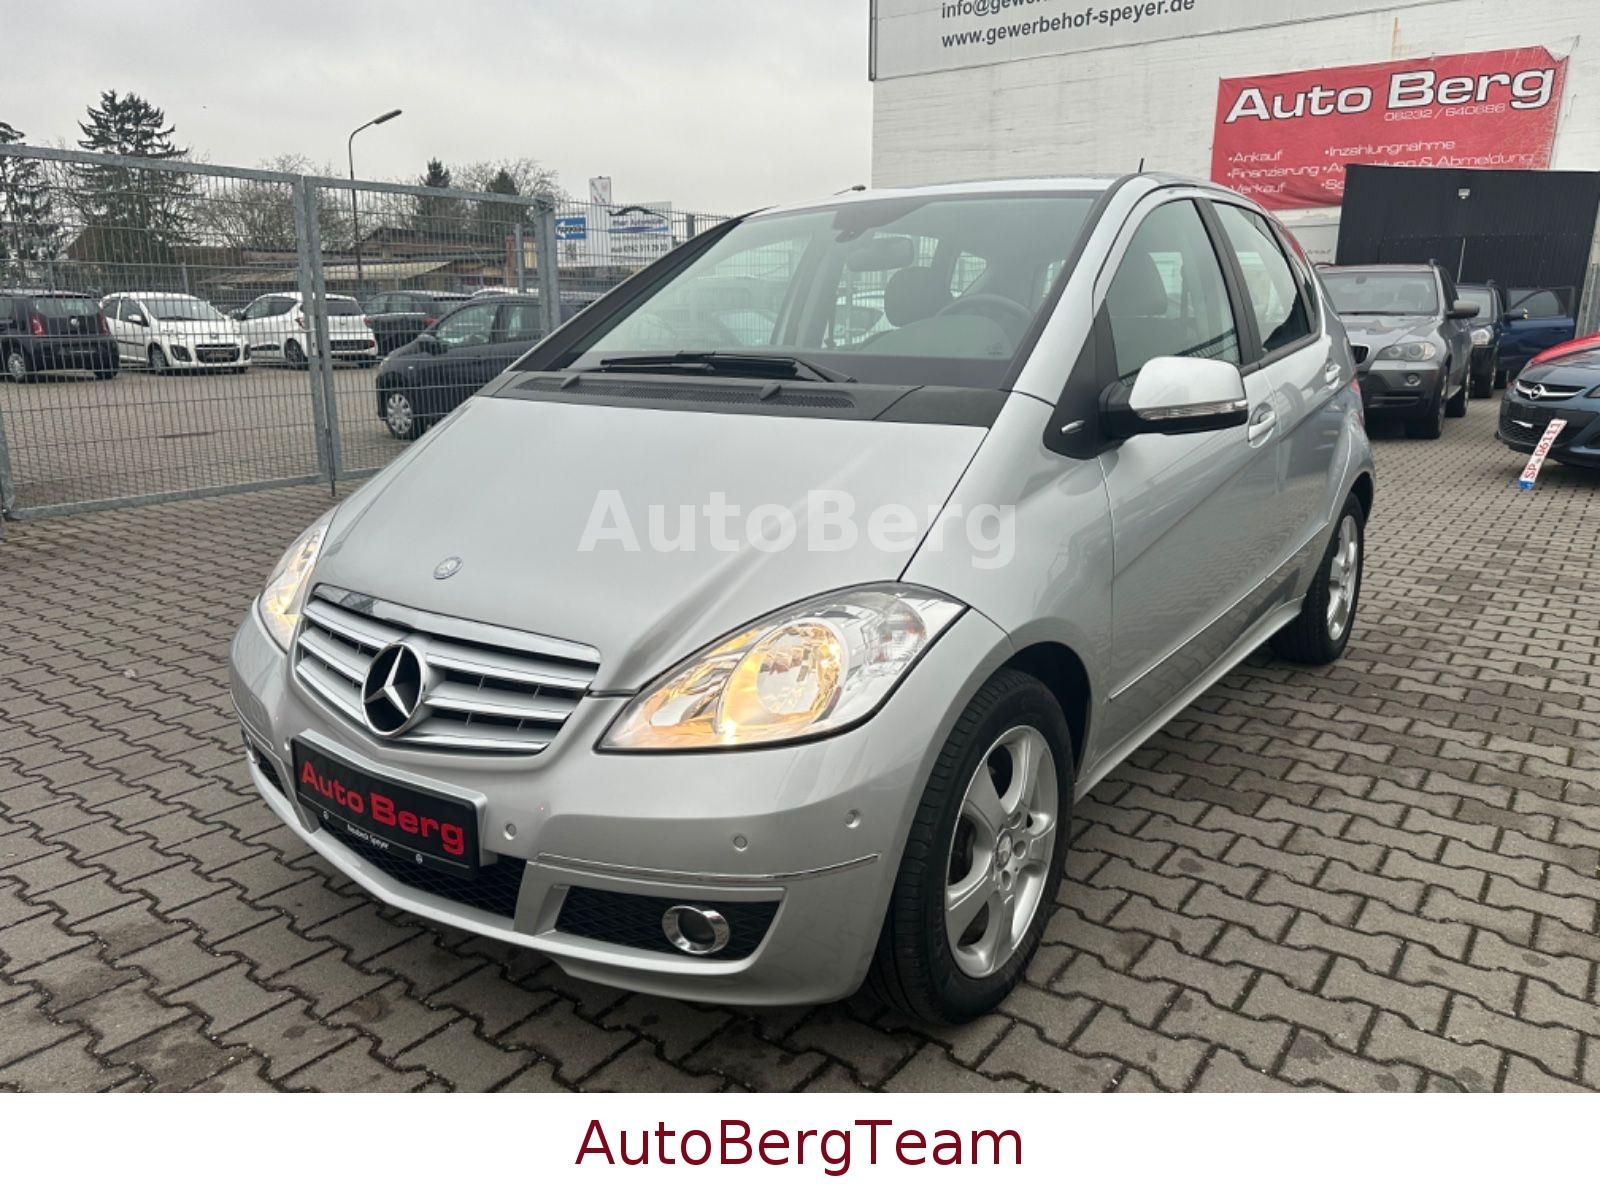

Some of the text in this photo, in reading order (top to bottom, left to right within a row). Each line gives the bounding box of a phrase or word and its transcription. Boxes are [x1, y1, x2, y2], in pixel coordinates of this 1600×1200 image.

[941, 0, 1195, 47] www.gewerbehof-speyer.de
[1223, 66, 1557, 124] Auto Berg
[1232, 150, 1283, 162] Ankauf
[1436, 153, 1535, 166] Abmeldung
[1231, 165, 1320, 178] Finanzierung
[302, 760, 365, 814] Auto
[370, 792, 465, 856] Berg
